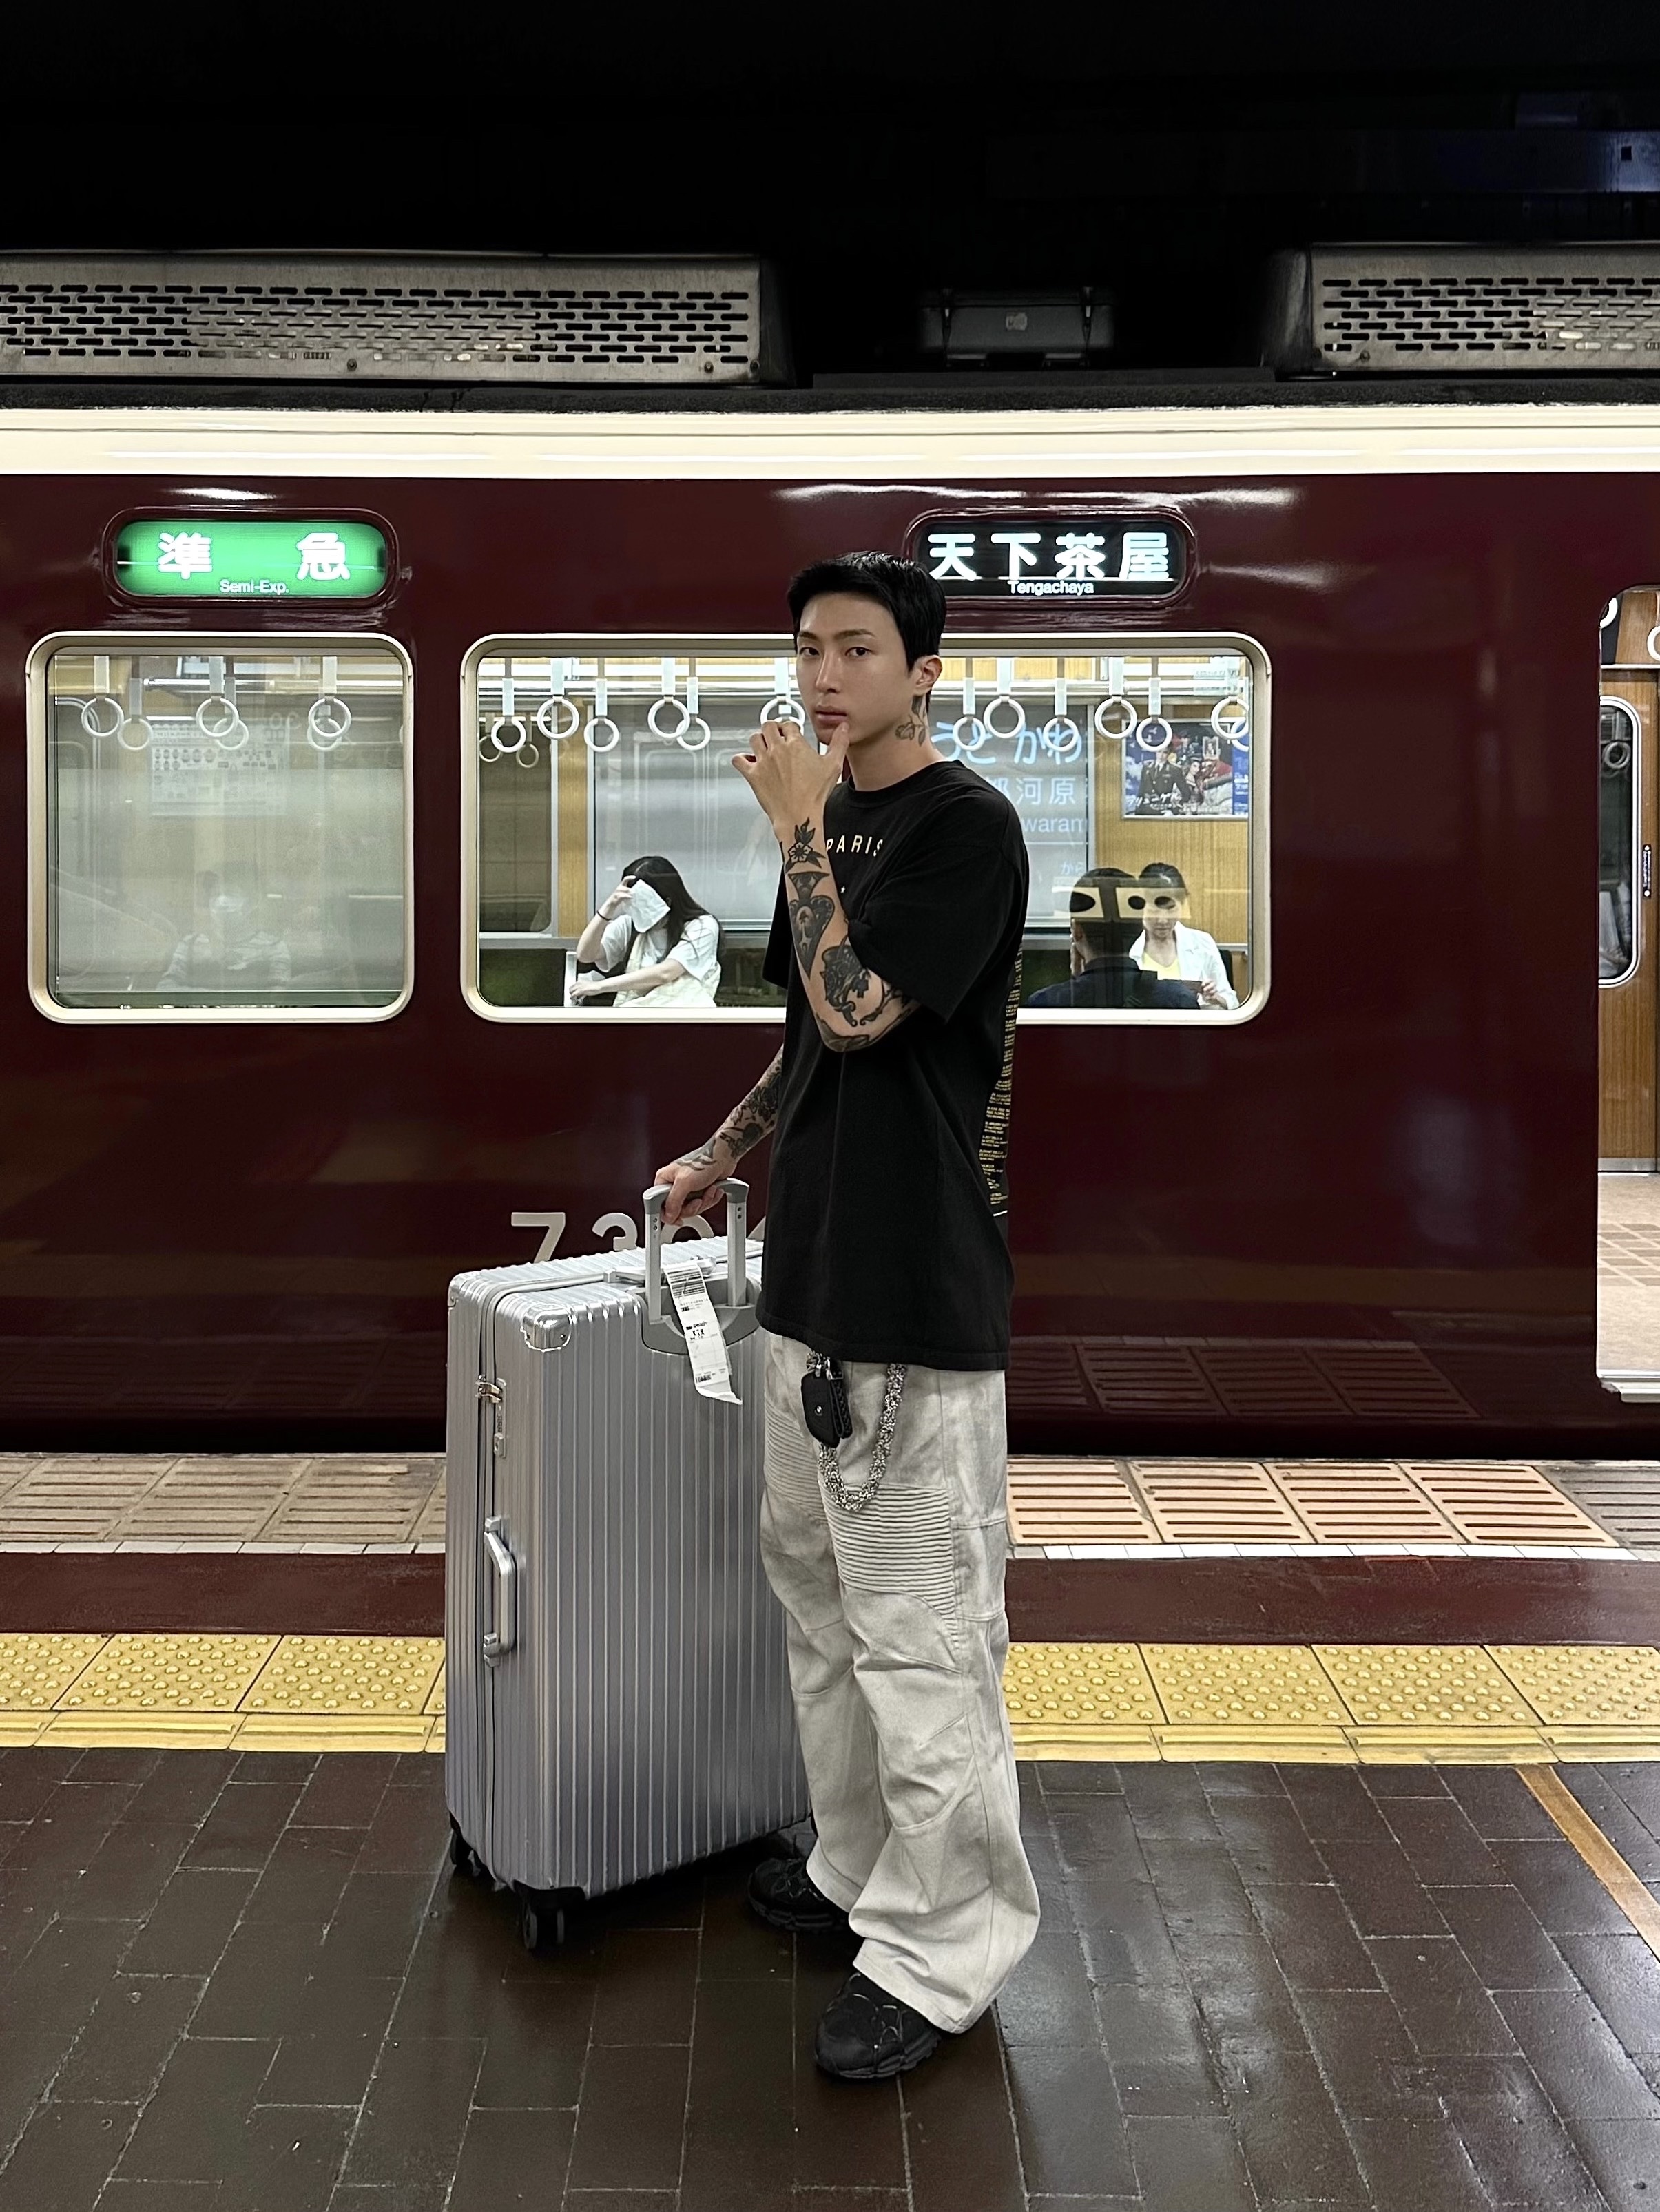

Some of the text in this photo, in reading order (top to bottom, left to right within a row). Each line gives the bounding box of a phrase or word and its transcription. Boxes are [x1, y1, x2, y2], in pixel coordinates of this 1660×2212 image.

[158, 532, 350, 580] 準急
[928, 532, 1169, 581] 天下茶屋
[219, 578, 289, 595] Semi-Exp.
[1008, 580, 1094, 596] Tengachaya
